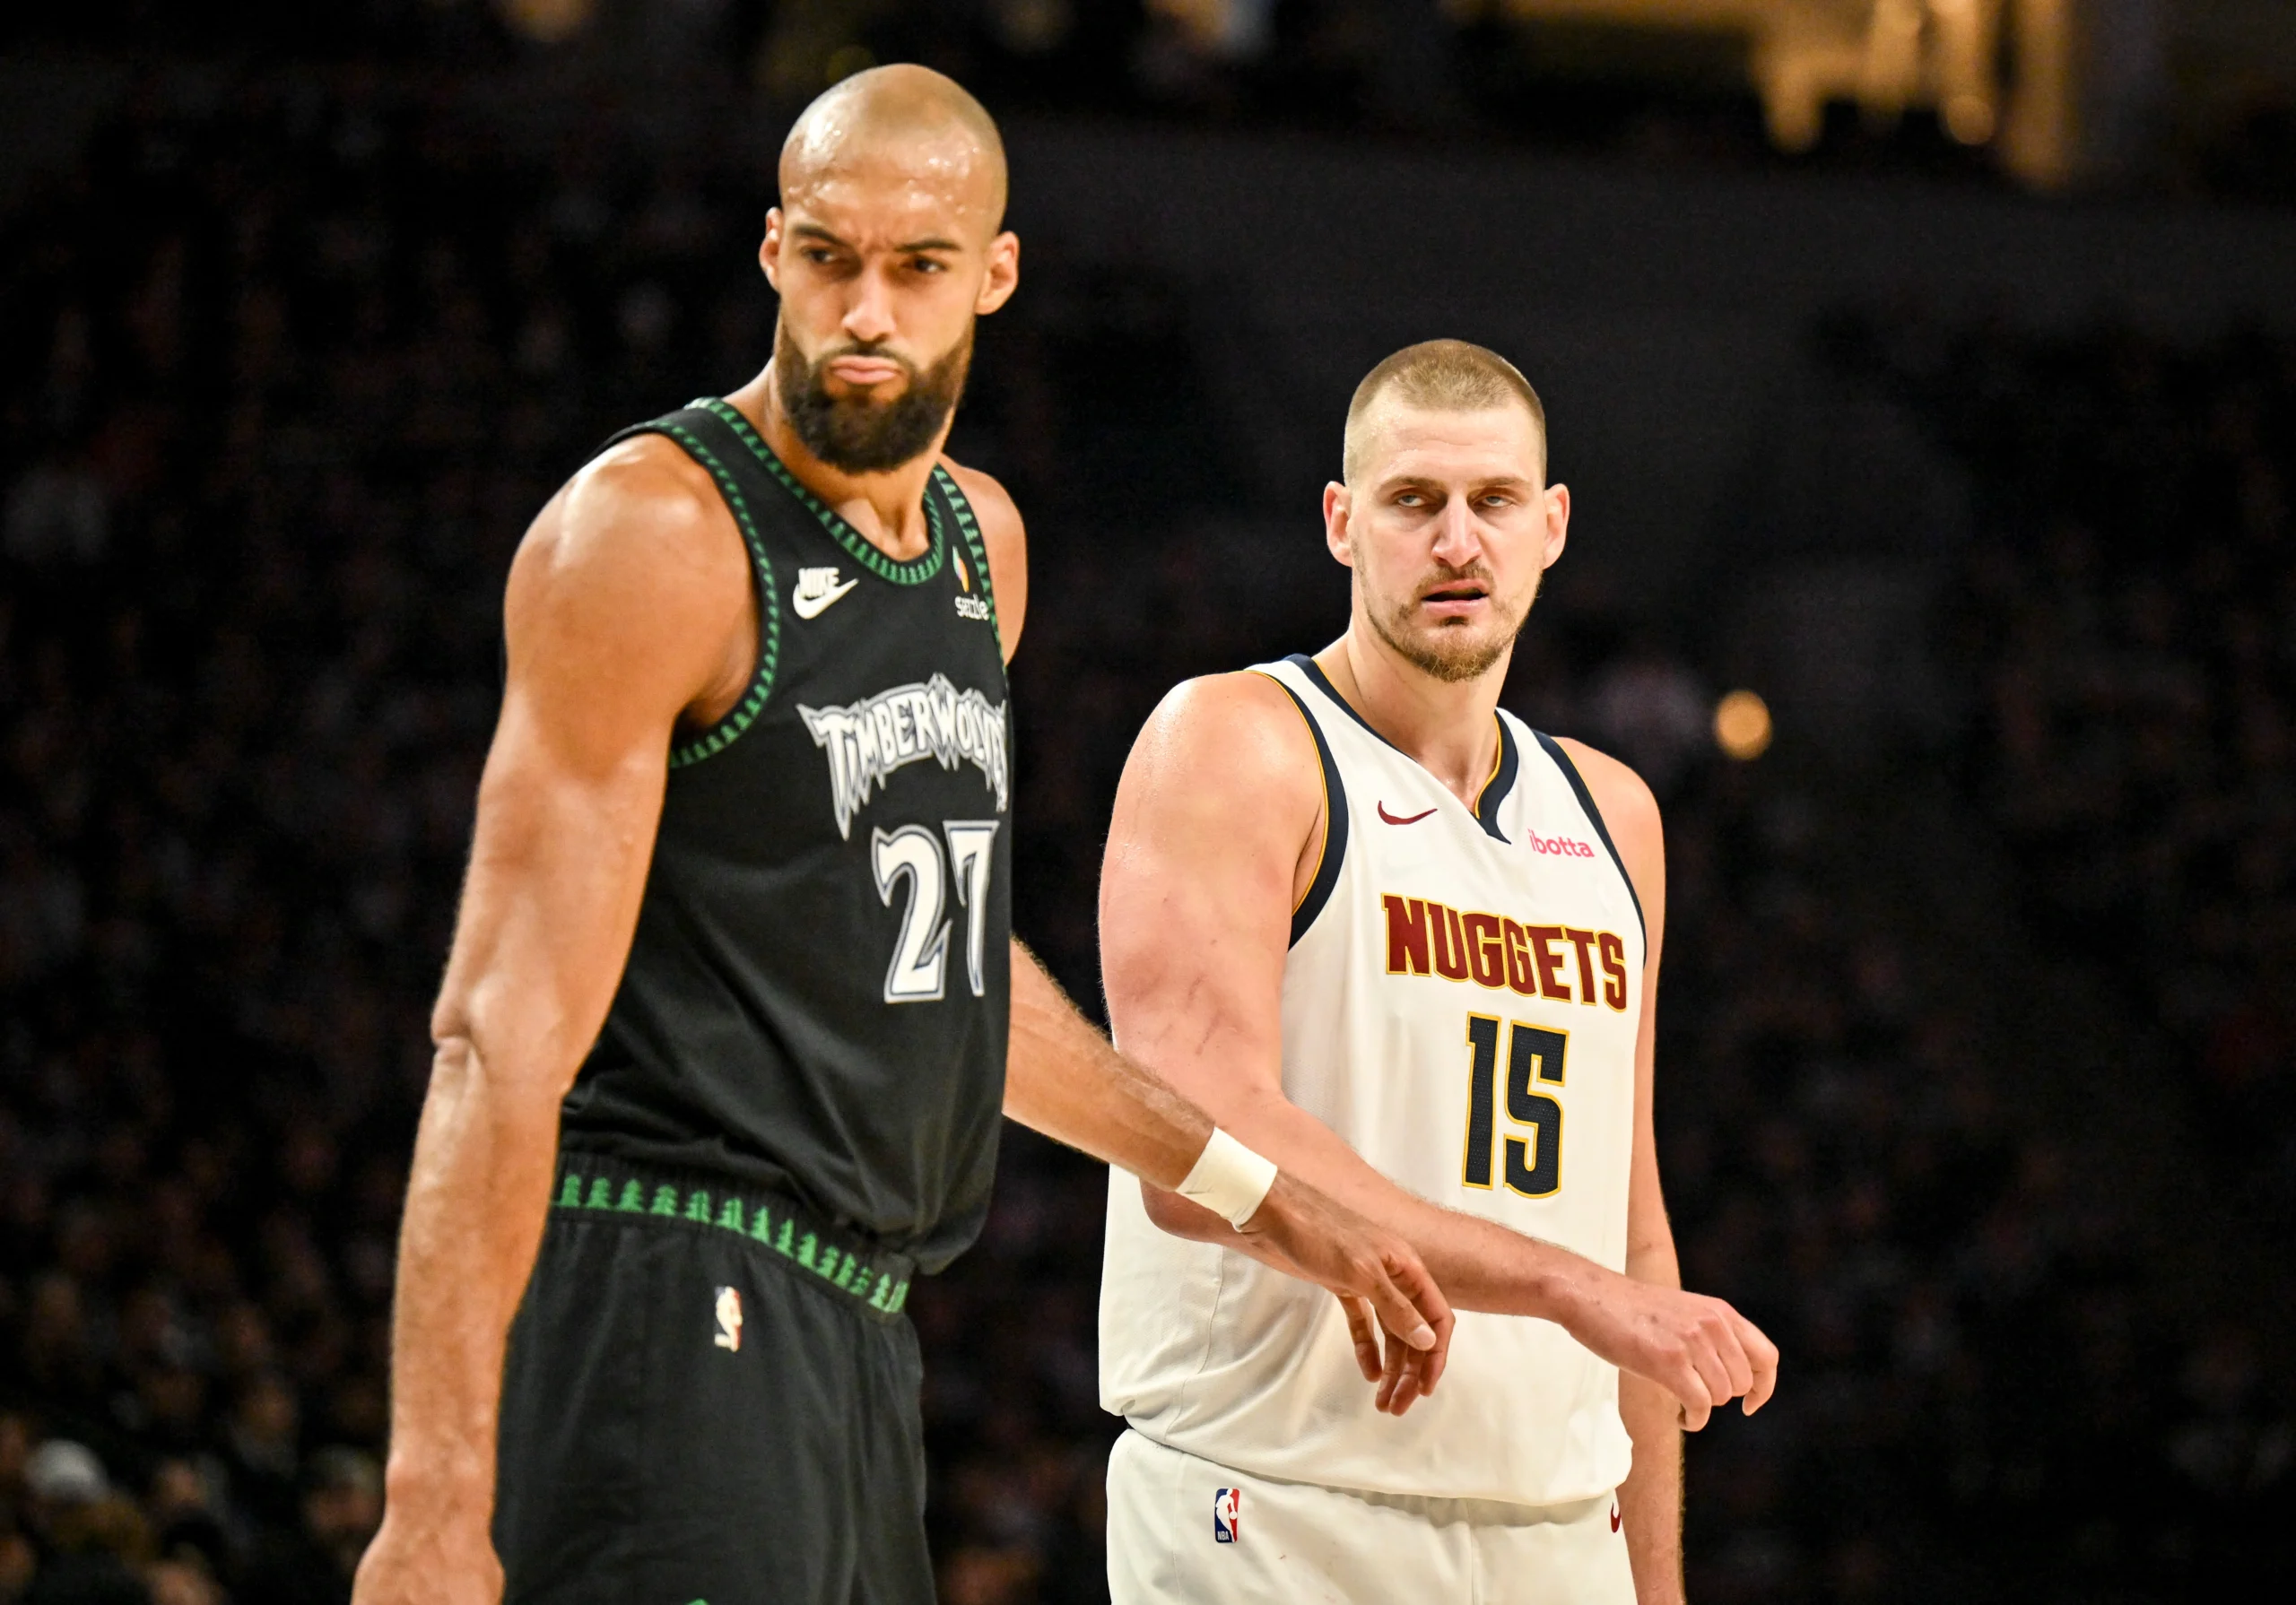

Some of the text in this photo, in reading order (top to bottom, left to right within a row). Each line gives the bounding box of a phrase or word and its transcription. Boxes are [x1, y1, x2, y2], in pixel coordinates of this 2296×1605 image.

[798, 567, 839, 598] NIKE
[1527, 828, 1595, 857] ibotta
[871, 820, 1000, 1004] 27
[1380, 892, 1627, 1012] NUGGETS
[1461, 1011, 1570, 1200] 15
[1217, 1531, 1230, 1540] NBA
